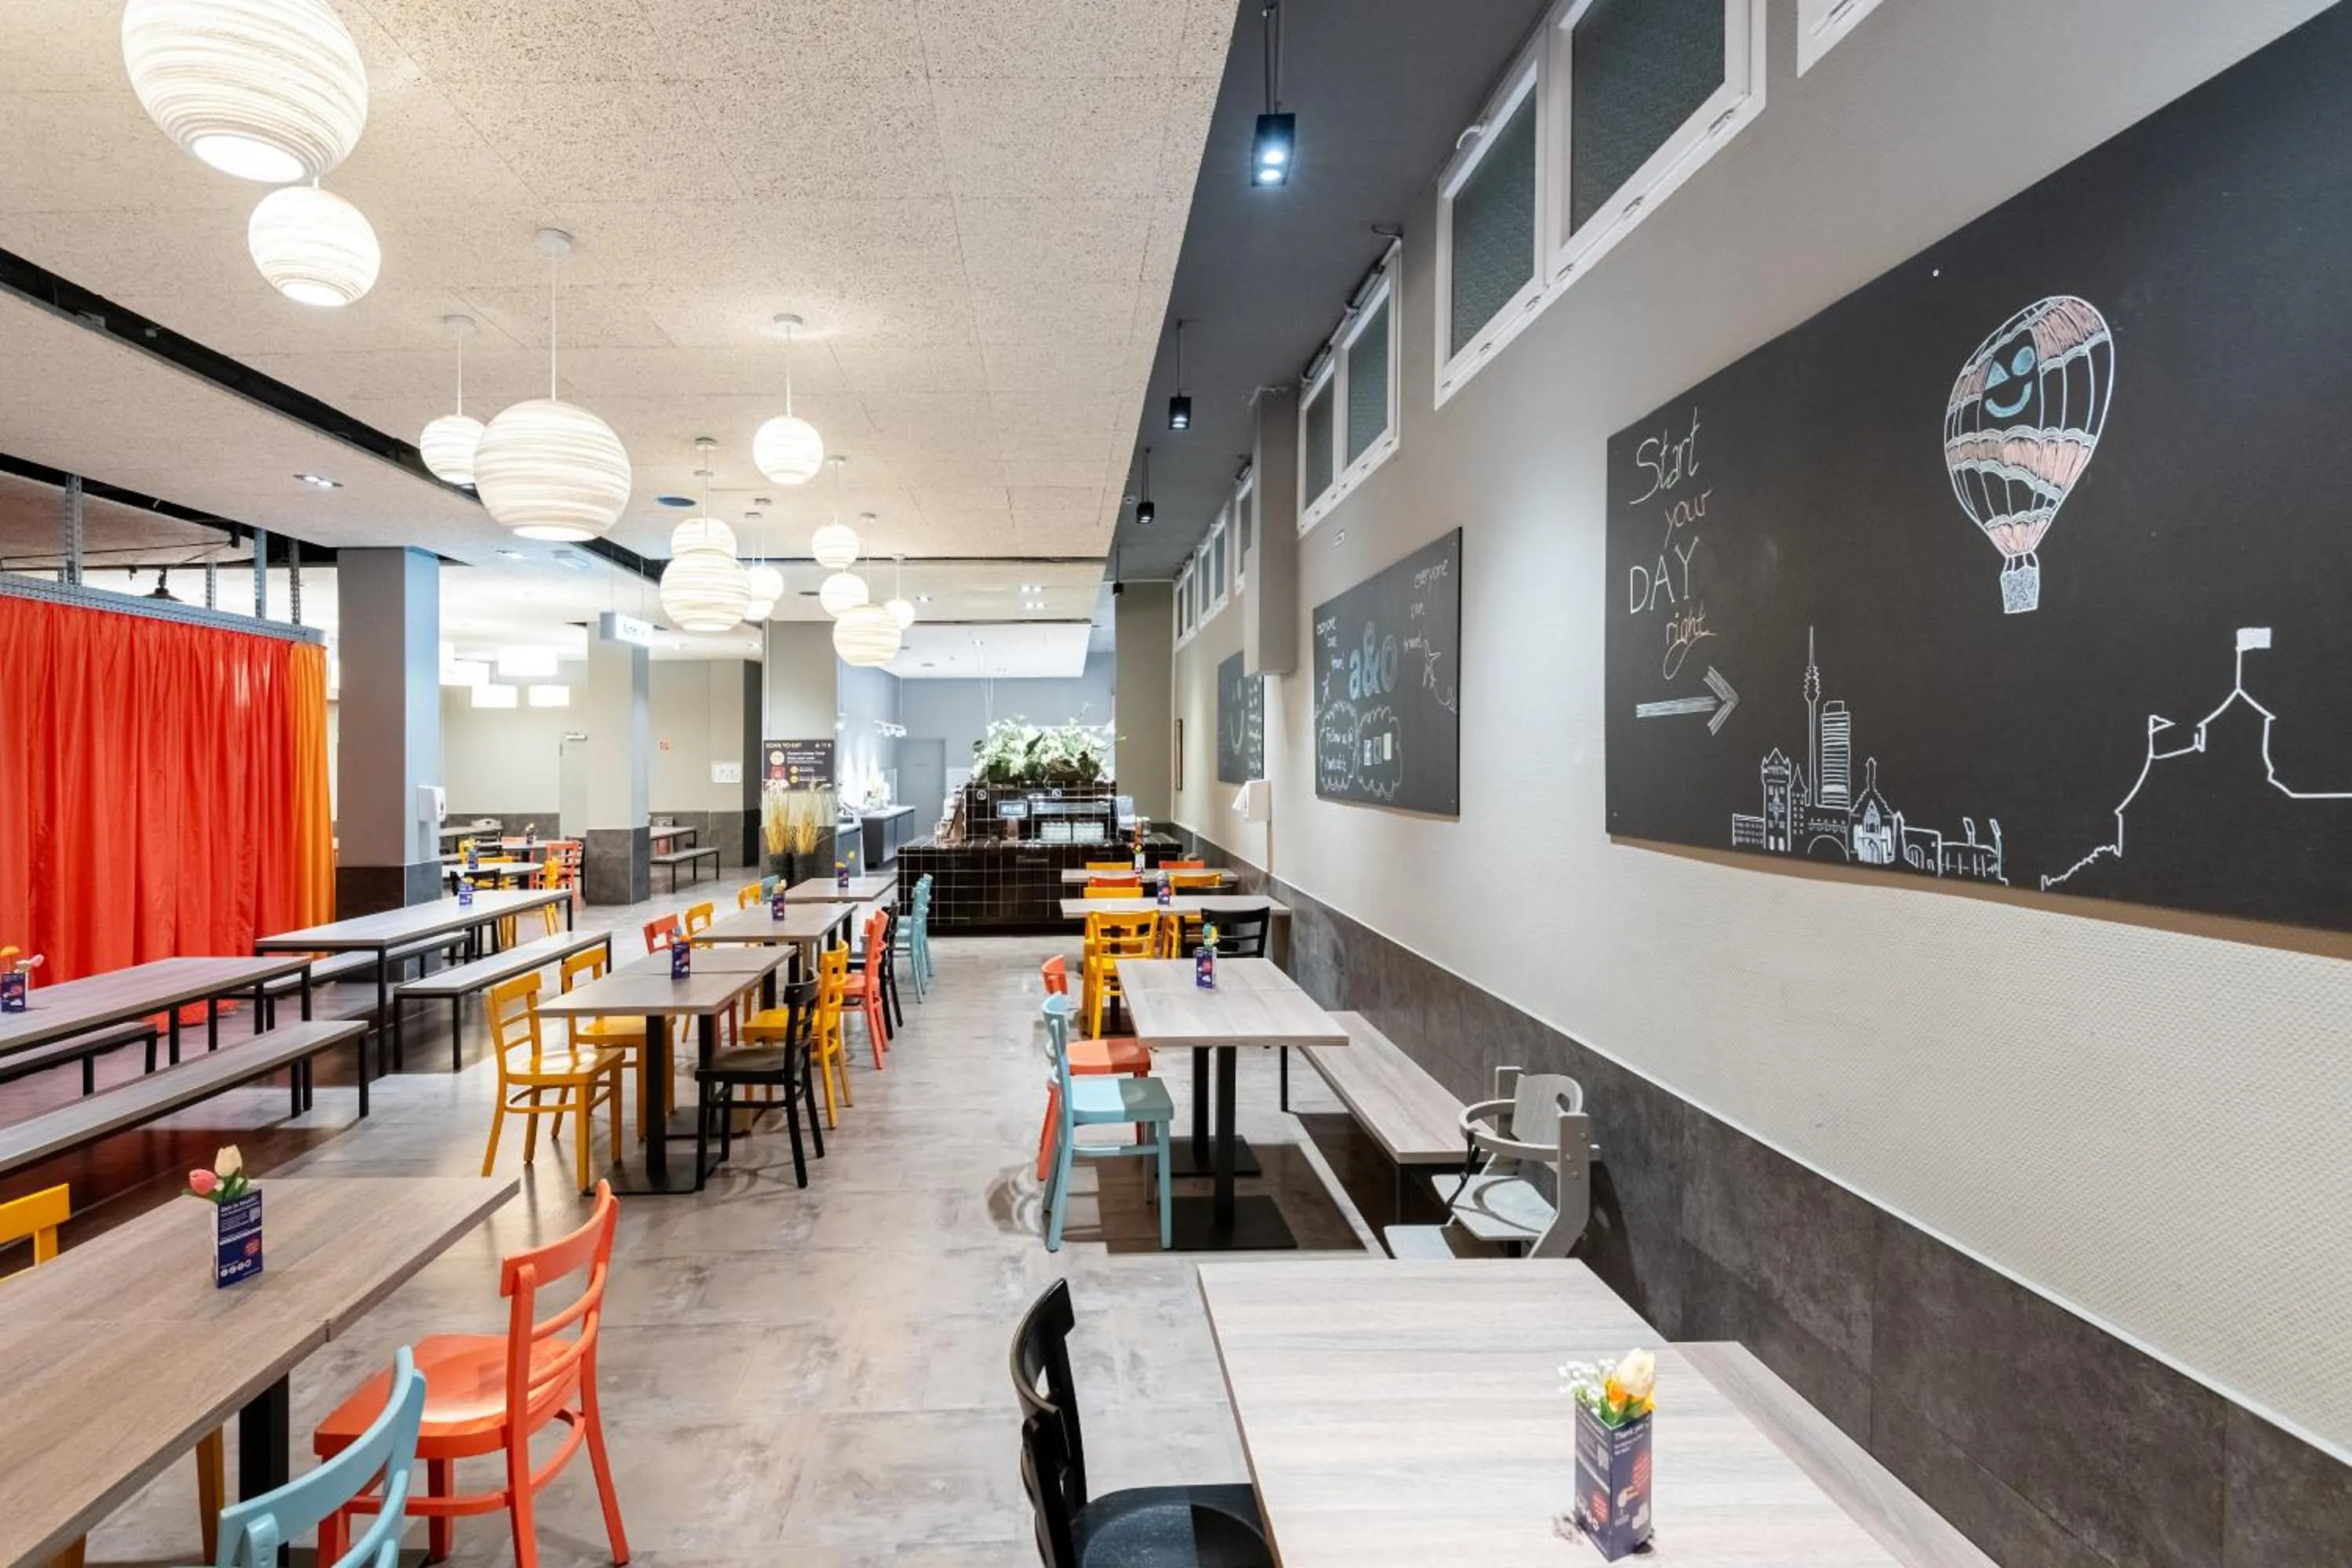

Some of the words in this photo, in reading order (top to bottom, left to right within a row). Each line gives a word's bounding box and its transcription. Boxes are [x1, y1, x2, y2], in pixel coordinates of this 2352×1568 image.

[1630, 406, 1700, 504] Start
[1664, 488, 1713, 550] your
[1630, 536, 1700, 614] DAY
